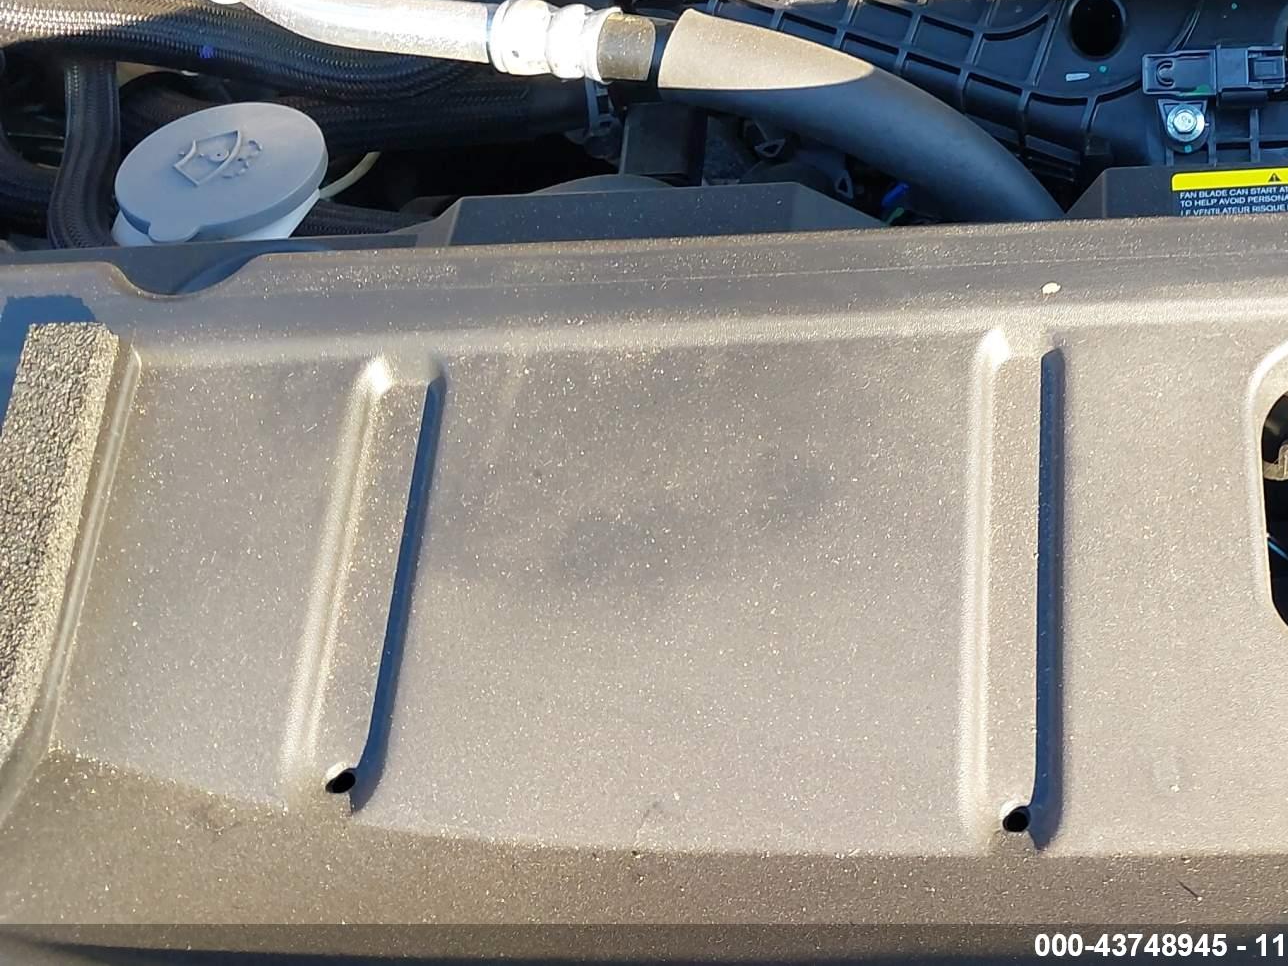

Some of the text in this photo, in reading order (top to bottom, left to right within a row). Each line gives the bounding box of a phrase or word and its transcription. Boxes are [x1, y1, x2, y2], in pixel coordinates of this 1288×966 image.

[1179, 191, 1197, 200] FAN
[1199, 189, 1228, 199] BLADE
[1229, 188, 1249, 197] CAN
[1250, 186, 1277, 196] START
[1180, 199, 1193, 207] TO
[1194, 197, 1217, 207] HELP
[1218, 196, 1246, 206] AVOID
[1251, 202, 1286, 213] RISQUE
